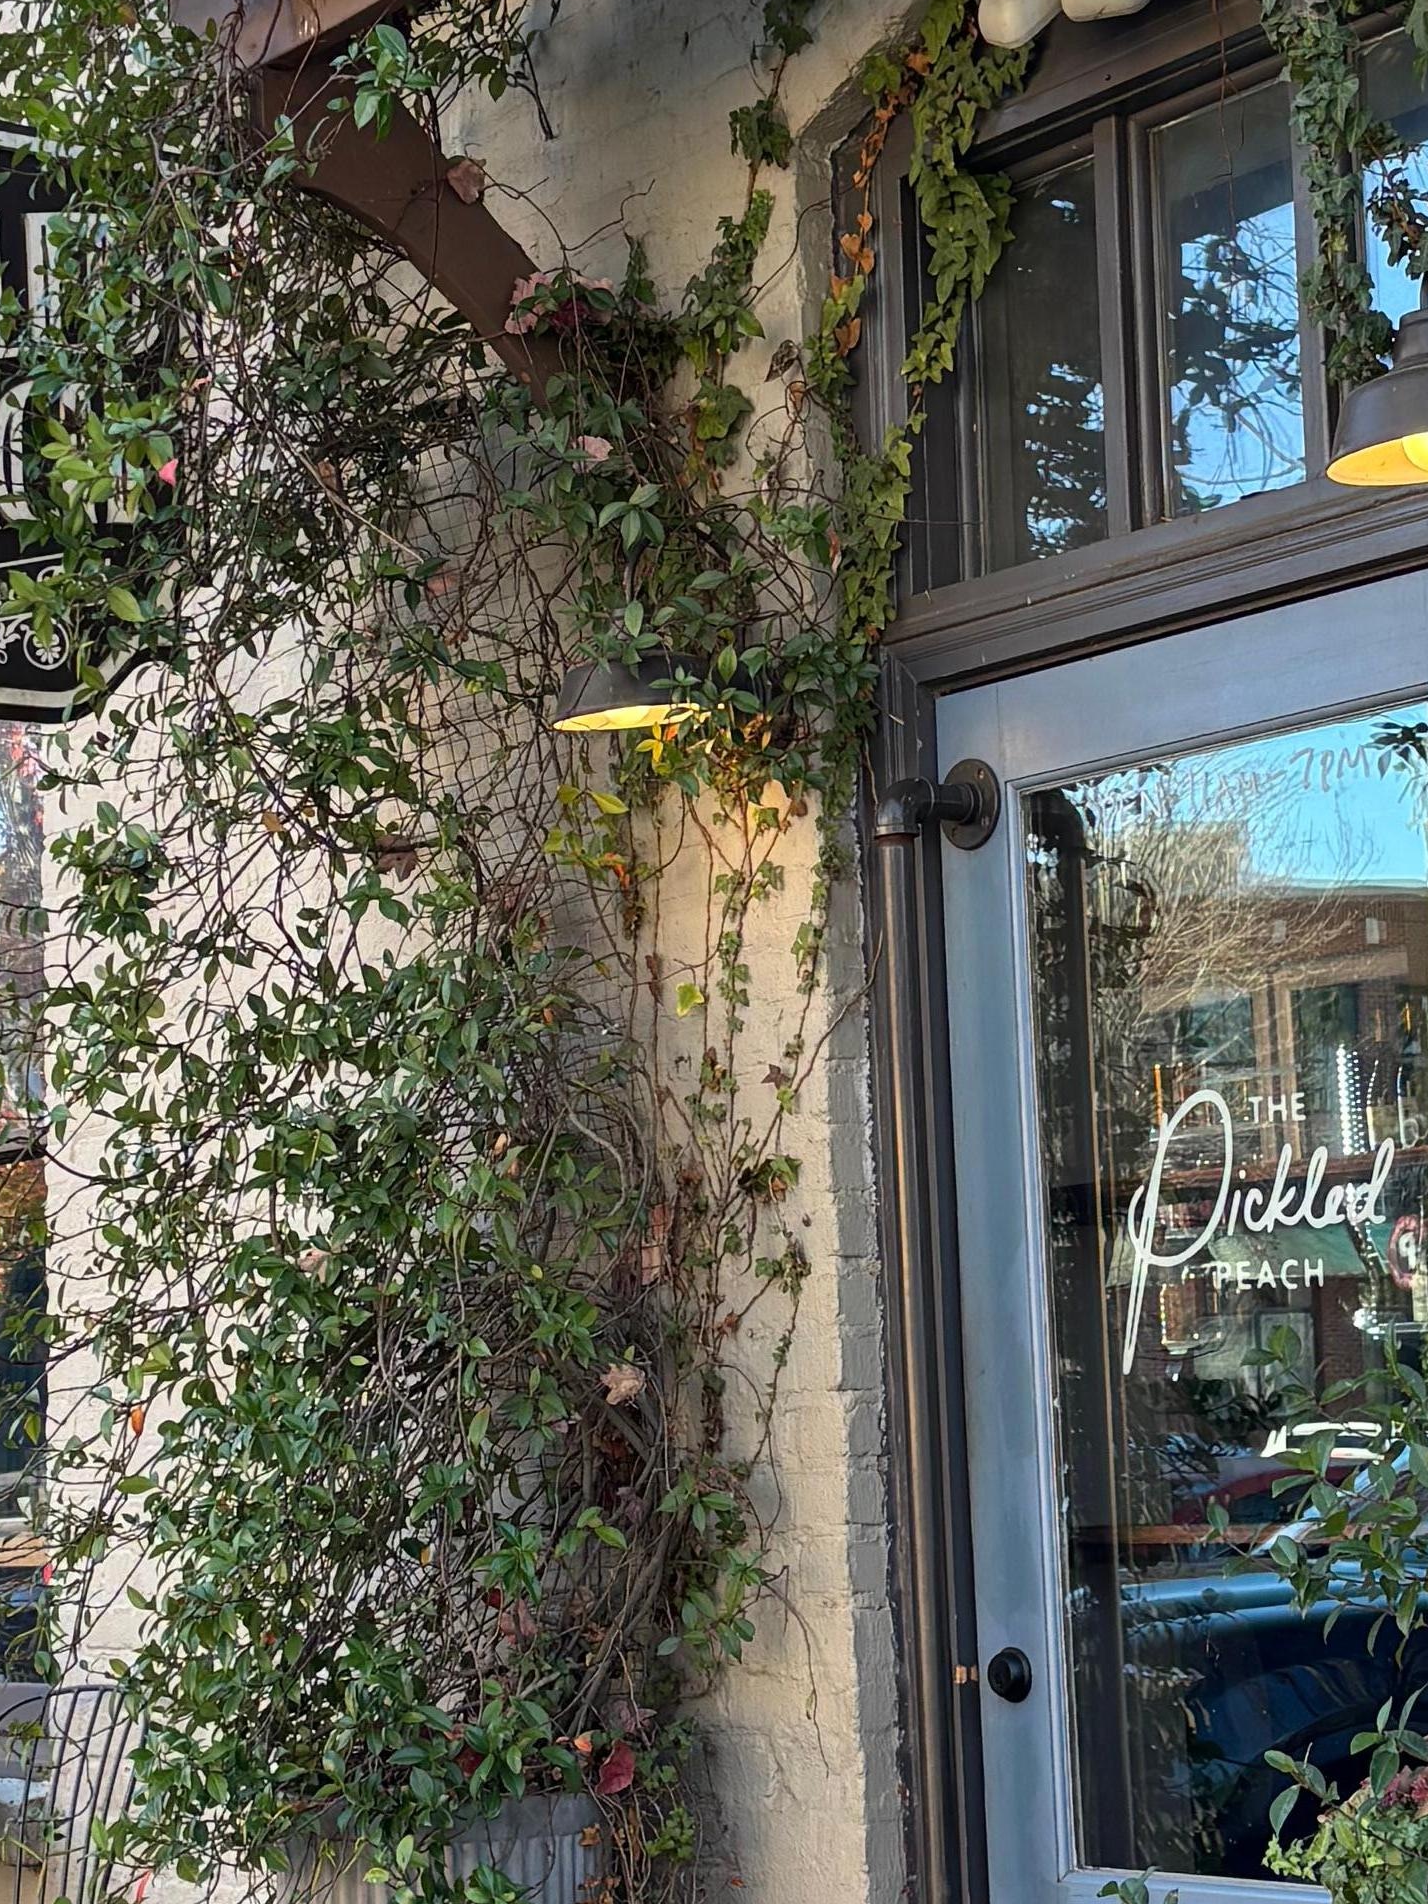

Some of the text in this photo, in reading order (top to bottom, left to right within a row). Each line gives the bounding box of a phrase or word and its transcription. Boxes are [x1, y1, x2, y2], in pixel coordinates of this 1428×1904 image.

[1248, 1091, 1307, 1124] THE
[1122, 1088, 1395, 1376] Pickled
[1215, 1257, 1325, 1291] PEACH
